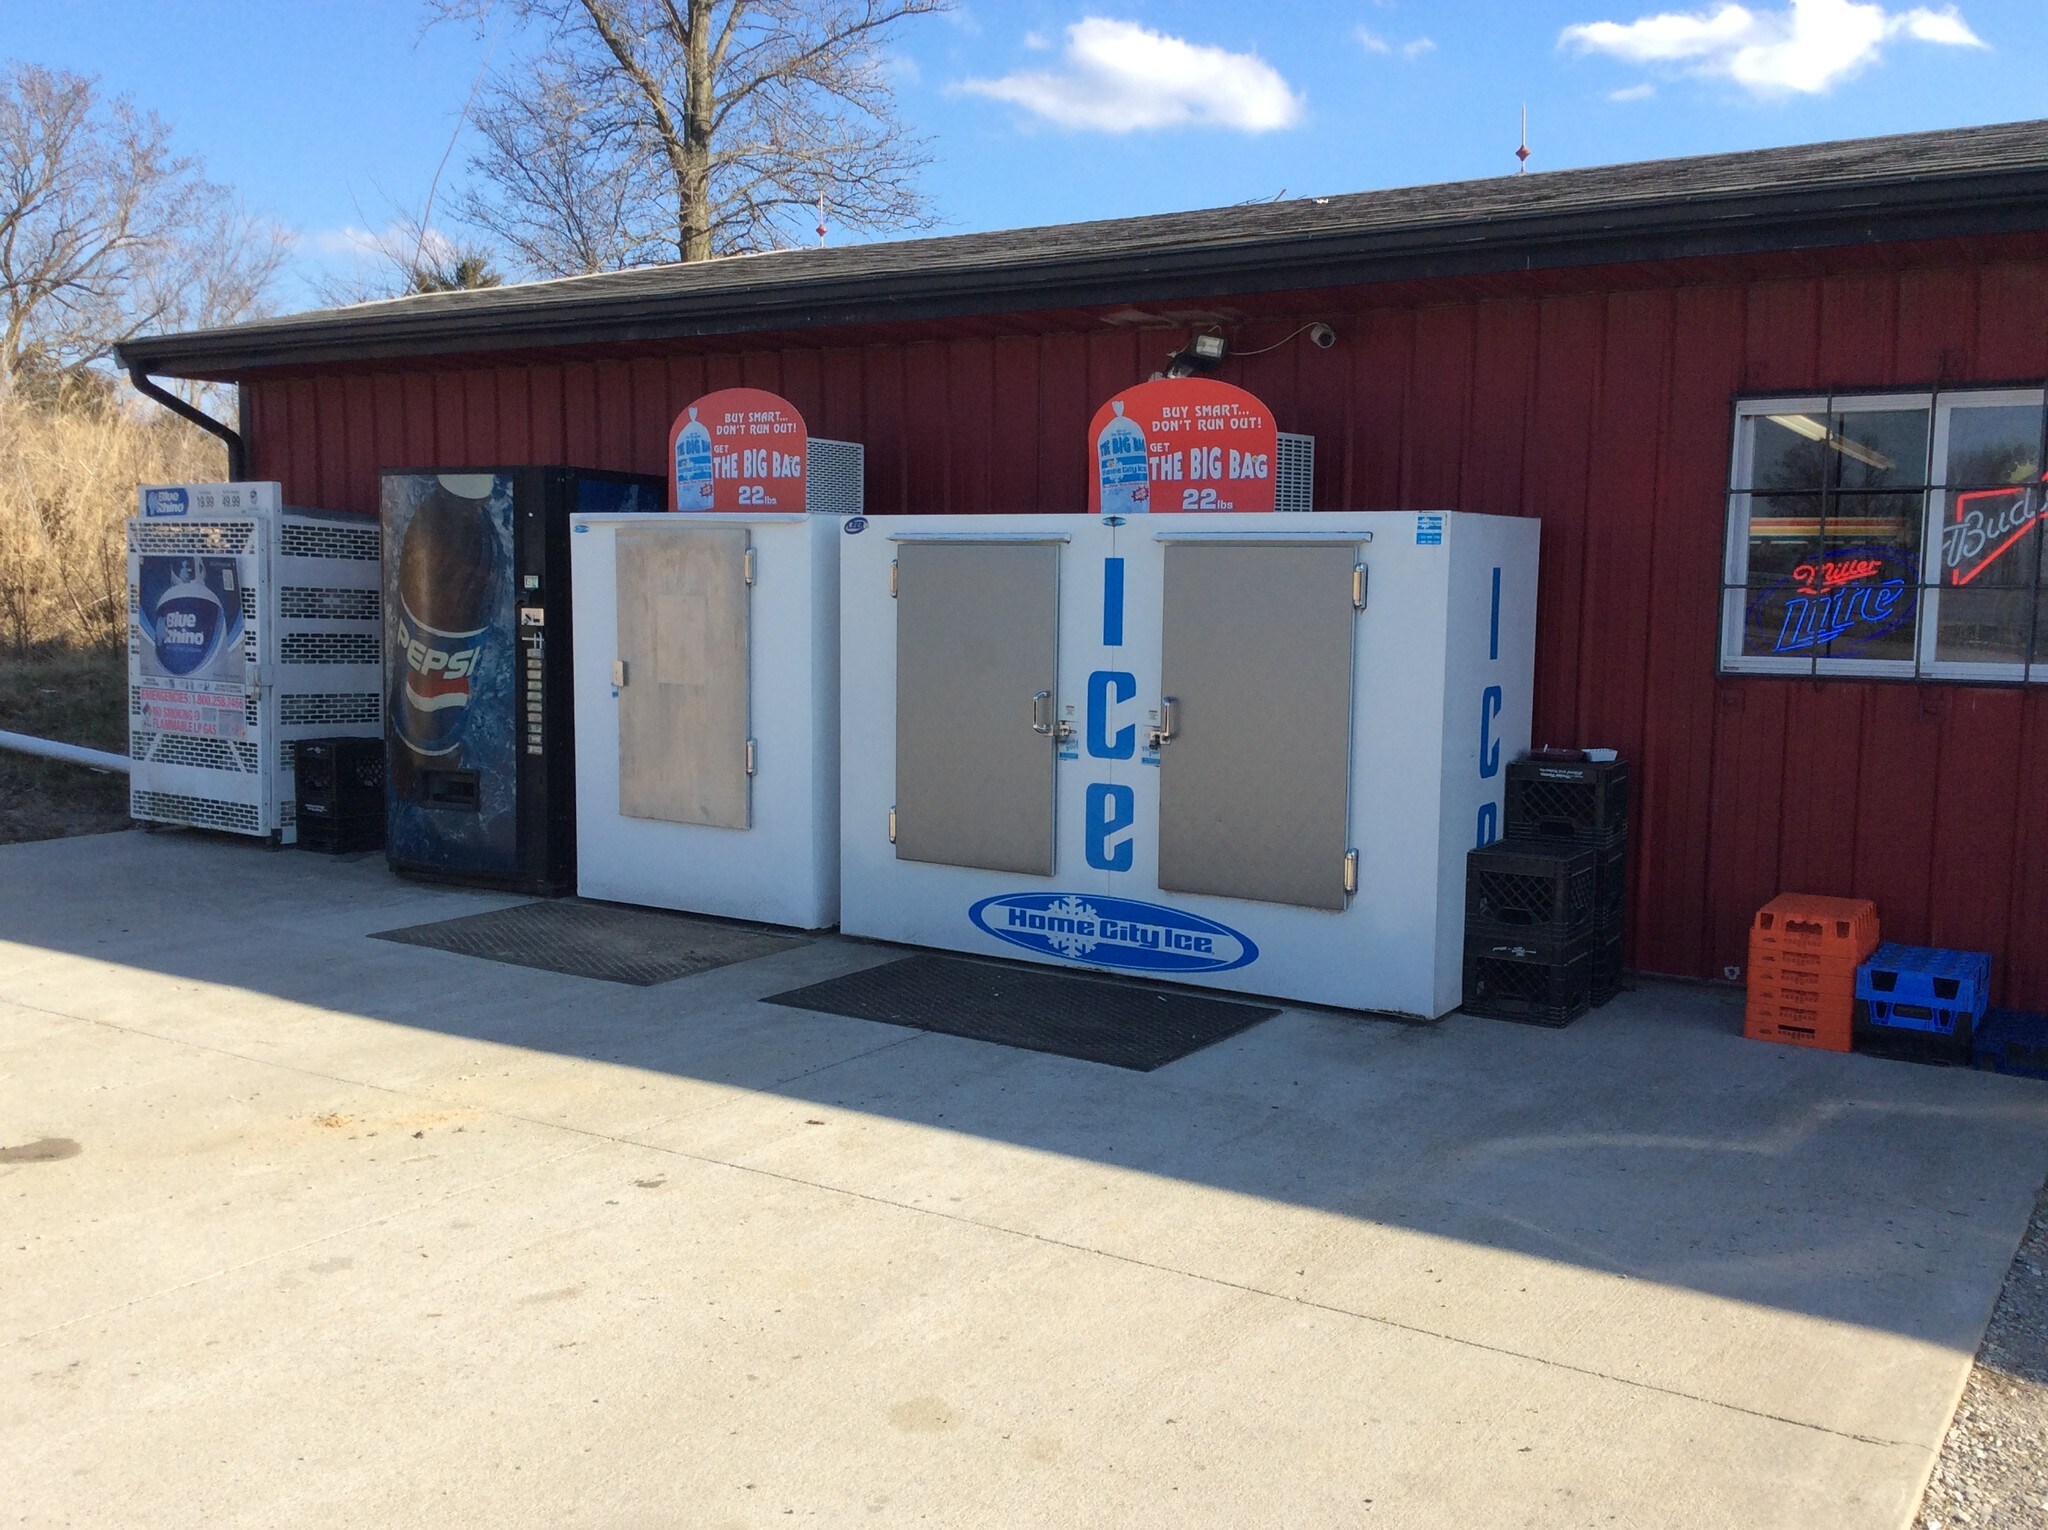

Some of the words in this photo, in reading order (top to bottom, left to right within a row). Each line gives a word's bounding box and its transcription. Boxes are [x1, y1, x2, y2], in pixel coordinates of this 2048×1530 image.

[724, 413, 745, 424] BUY
[748, 411, 788, 423] SMART...
[1162, 406, 1189, 418] BUY
[1195, 403, 1250, 417] SMART...
[716, 424, 746, 436] DON'T
[750, 424, 770, 434] RUN
[773, 422, 797, 434] OUT!
[1152, 420, 1191, 432] DON'T
[1197, 418, 1225, 431] RUN
[1230, 417, 1262, 430] OUT!
[713, 444, 729, 454] GET
[1149, 442, 1170, 453] GET
[713, 452, 738, 479] THE
[743, 448, 768, 478] BIG
[772, 450, 801, 478] BAG
[1149, 451, 1183, 481] THE
[1190, 446, 1222, 480] BIG
[1229, 448, 1268, 480] BAG
[159, 491, 180, 502] Blue
[166, 611, 197, 628] Blue
[397, 617, 481, 680] PEPSI
[153, 706, 161, 716] NO
[163, 707, 193, 720] SMOKING
[1085, 557, 1137, 873] Ice
[153, 718, 192, 733] FLAMMABLE
[193, 722, 202, 733] LP
[203, 723, 217, 735] GAS
[1008, 908, 1095, 938] Home
[1099, 919, 1160, 949] City
[1164, 928, 1213, 953] Ice
